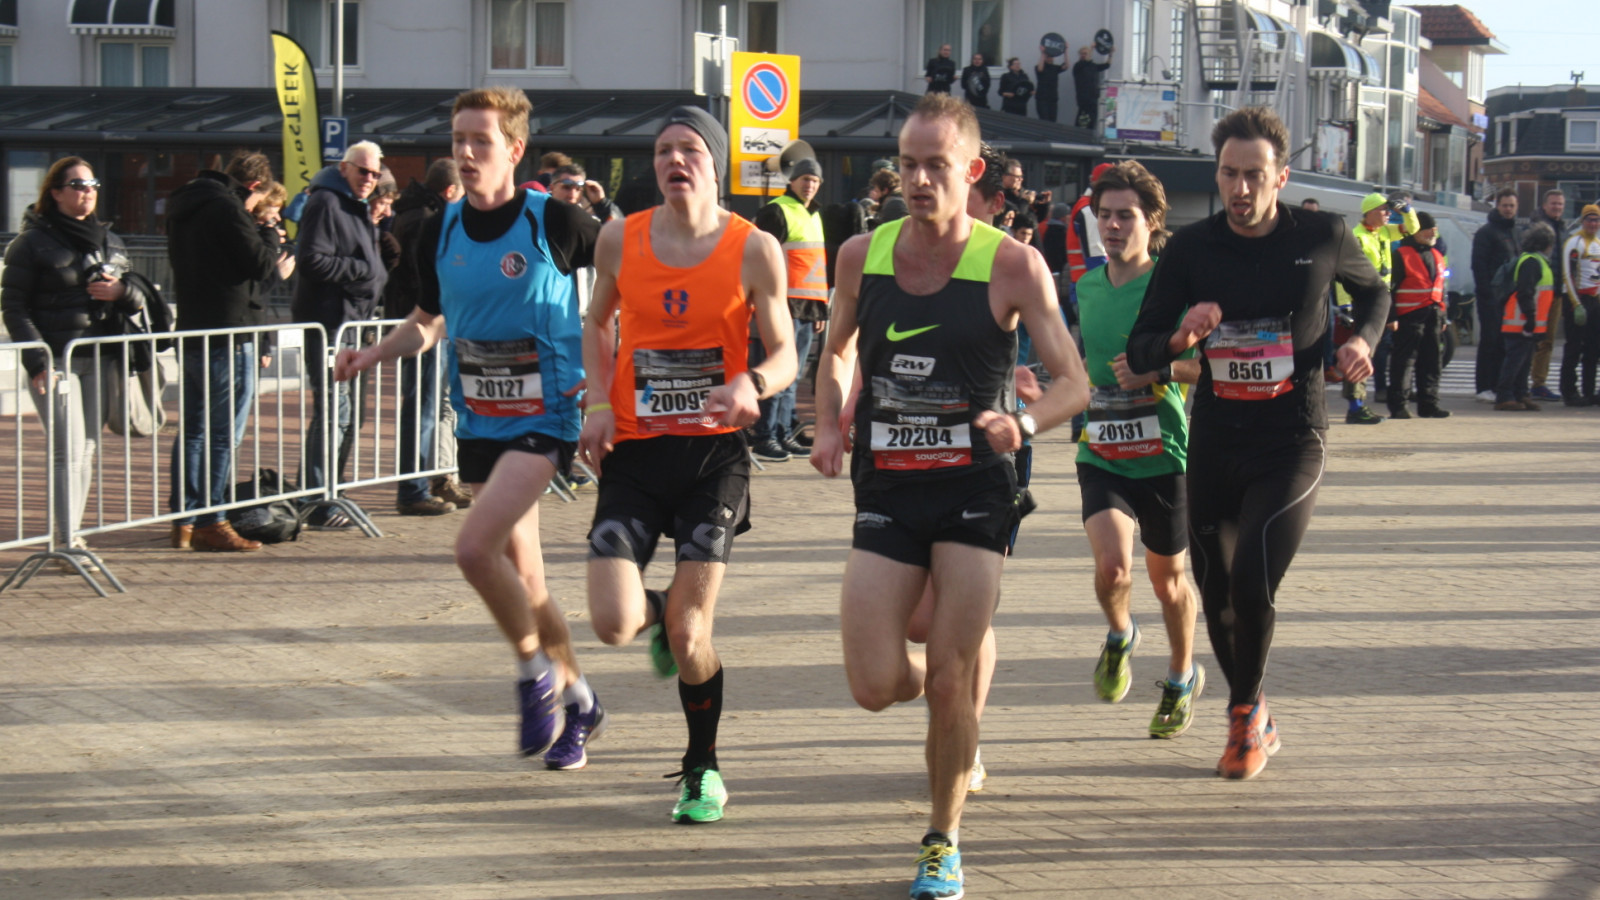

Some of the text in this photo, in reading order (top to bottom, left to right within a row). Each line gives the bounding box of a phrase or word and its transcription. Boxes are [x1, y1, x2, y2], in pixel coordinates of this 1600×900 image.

[326, 121, 341, 143] P
[1228, 360, 1272, 380] 8561
[475, 379, 524, 398] 20127
[897, 414, 938, 425] Saucony
[886, 426, 953, 447] 20204
[1098, 421, 1144, 441] 20131
[915, 451, 954, 461] saucony
